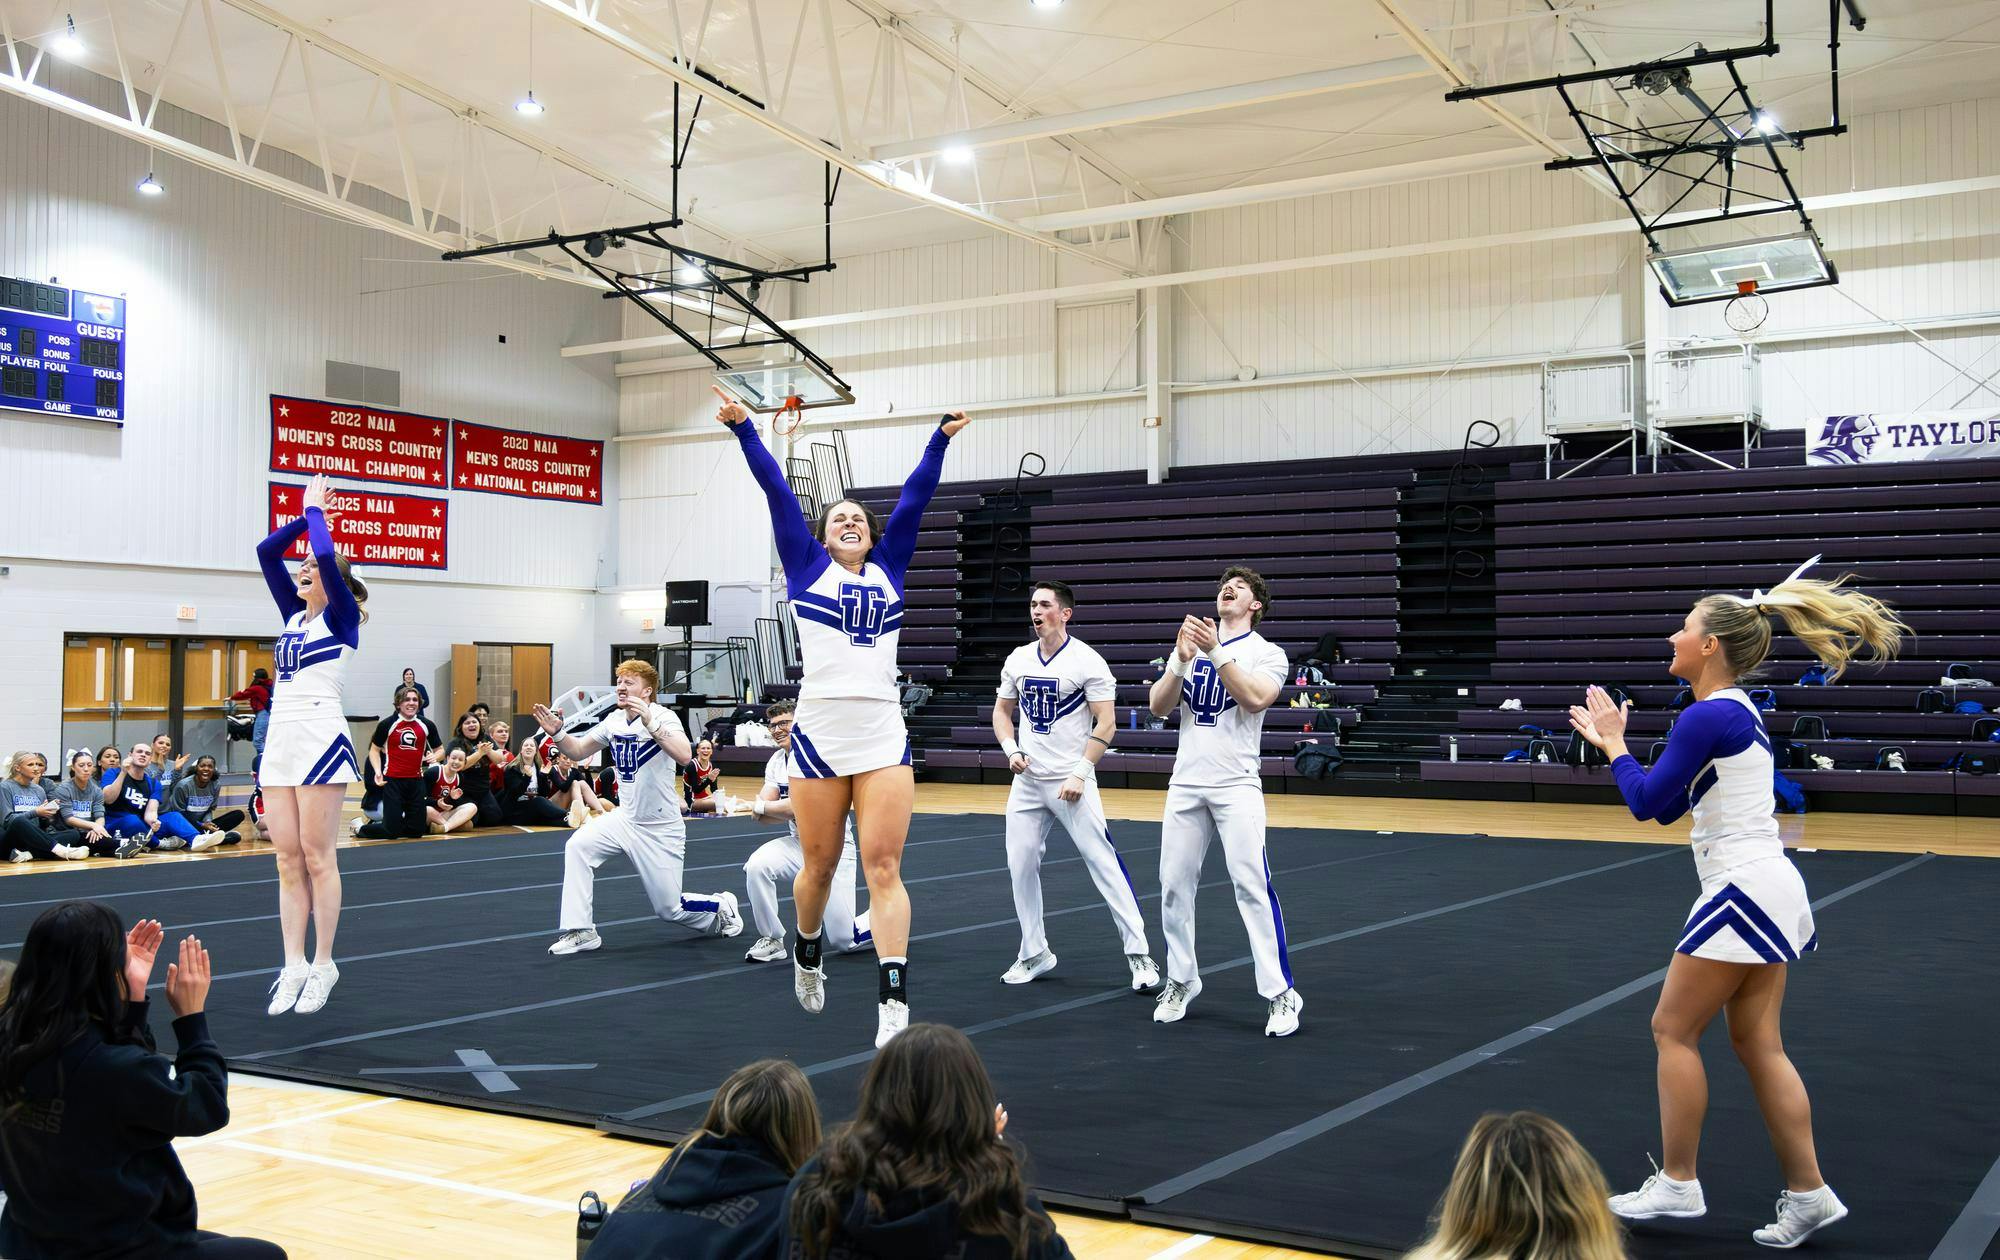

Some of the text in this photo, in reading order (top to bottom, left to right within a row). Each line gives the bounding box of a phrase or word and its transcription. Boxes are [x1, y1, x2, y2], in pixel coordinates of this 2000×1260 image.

[48, 335, 70, 346] POSS
[77, 323, 124, 341] GUEST
[1, 355, 69, 373] PLAYER FOUL
[43, 349, 70, 360] BONUS
[93, 369, 122, 380] FOULS
[44, 402, 71, 412] GAME
[96, 408, 117, 418] WON
[330, 411, 395, 432] 2022 NAIA
[278, 427, 442, 459] WOMEN'S CROSS COUNTRY
[1887, 420, 2000, 448] TAYLOR
[503, 436, 558, 455] 2020 NAIA
[297, 453, 426, 480] NATIONAL CHAMPION
[467, 451, 591, 478] MEN'S CROSS COUNTRY
[474, 473, 583, 497] NATIONAL CHAMPION
[330, 497, 395, 514] 2025 NAIA
[341, 519, 381, 535] CROSS
[388, 523, 441, 540] COUNTRY
[296, 540, 425, 561] NANAL CHAMPION
[124, 786, 149, 810] USF
